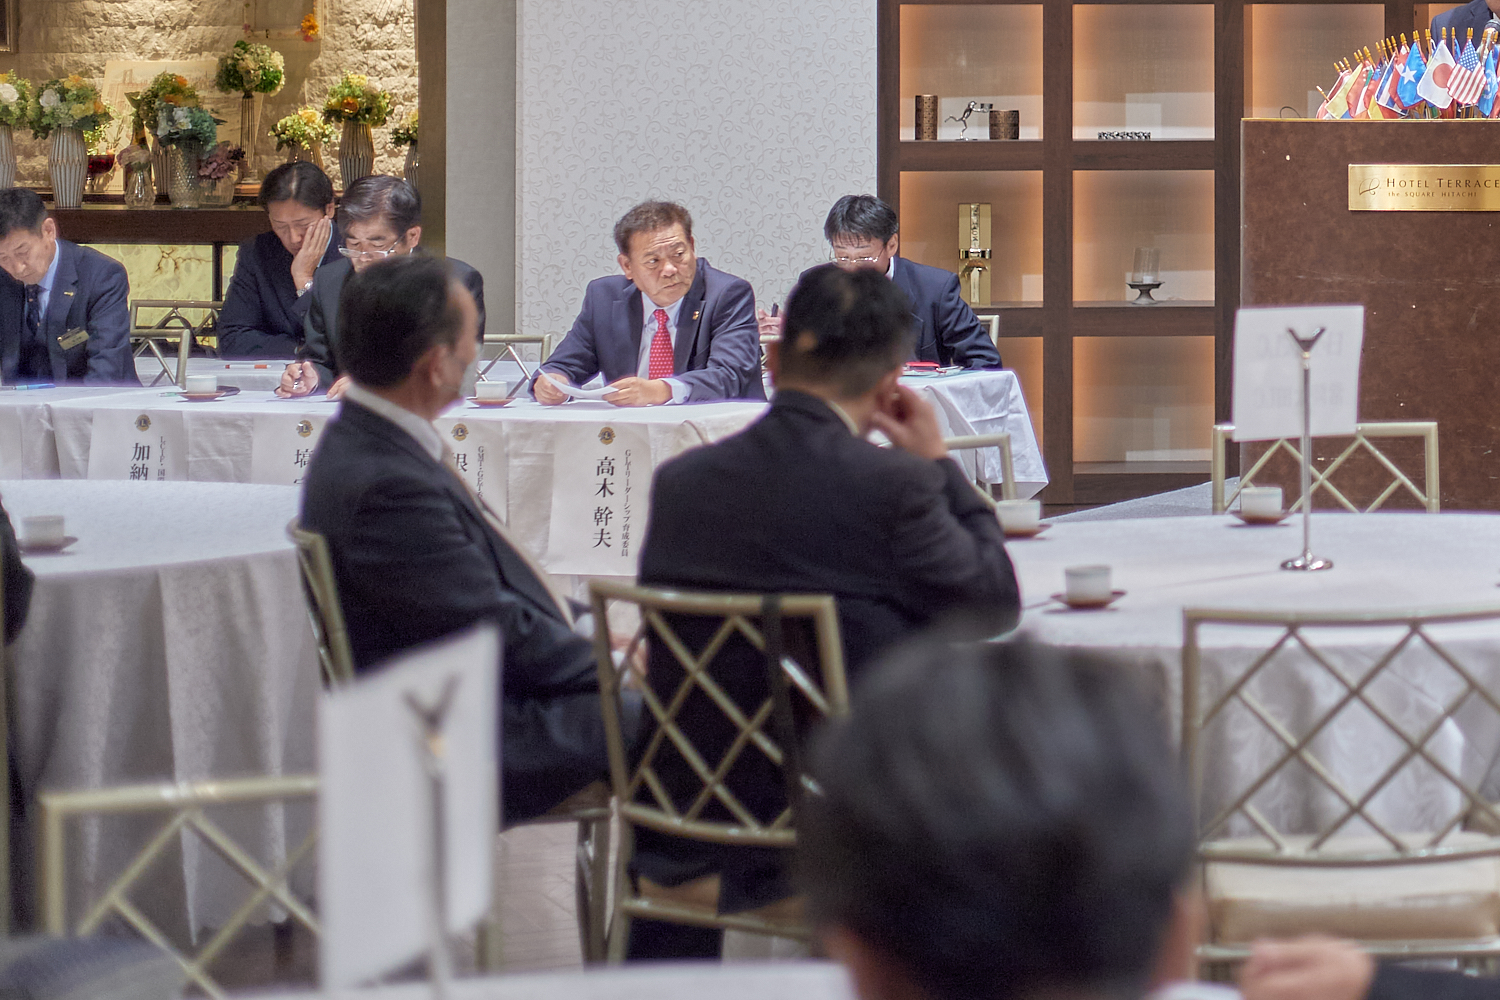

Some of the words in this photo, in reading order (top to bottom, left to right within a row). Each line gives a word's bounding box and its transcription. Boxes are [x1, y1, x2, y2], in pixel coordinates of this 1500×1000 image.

[1386, 178, 1430, 188] HOTEL
[1437, 178, 1500, 188] TERRACE
[595, 456, 615, 498] 高木
[592, 506, 613, 549] 幹夫
